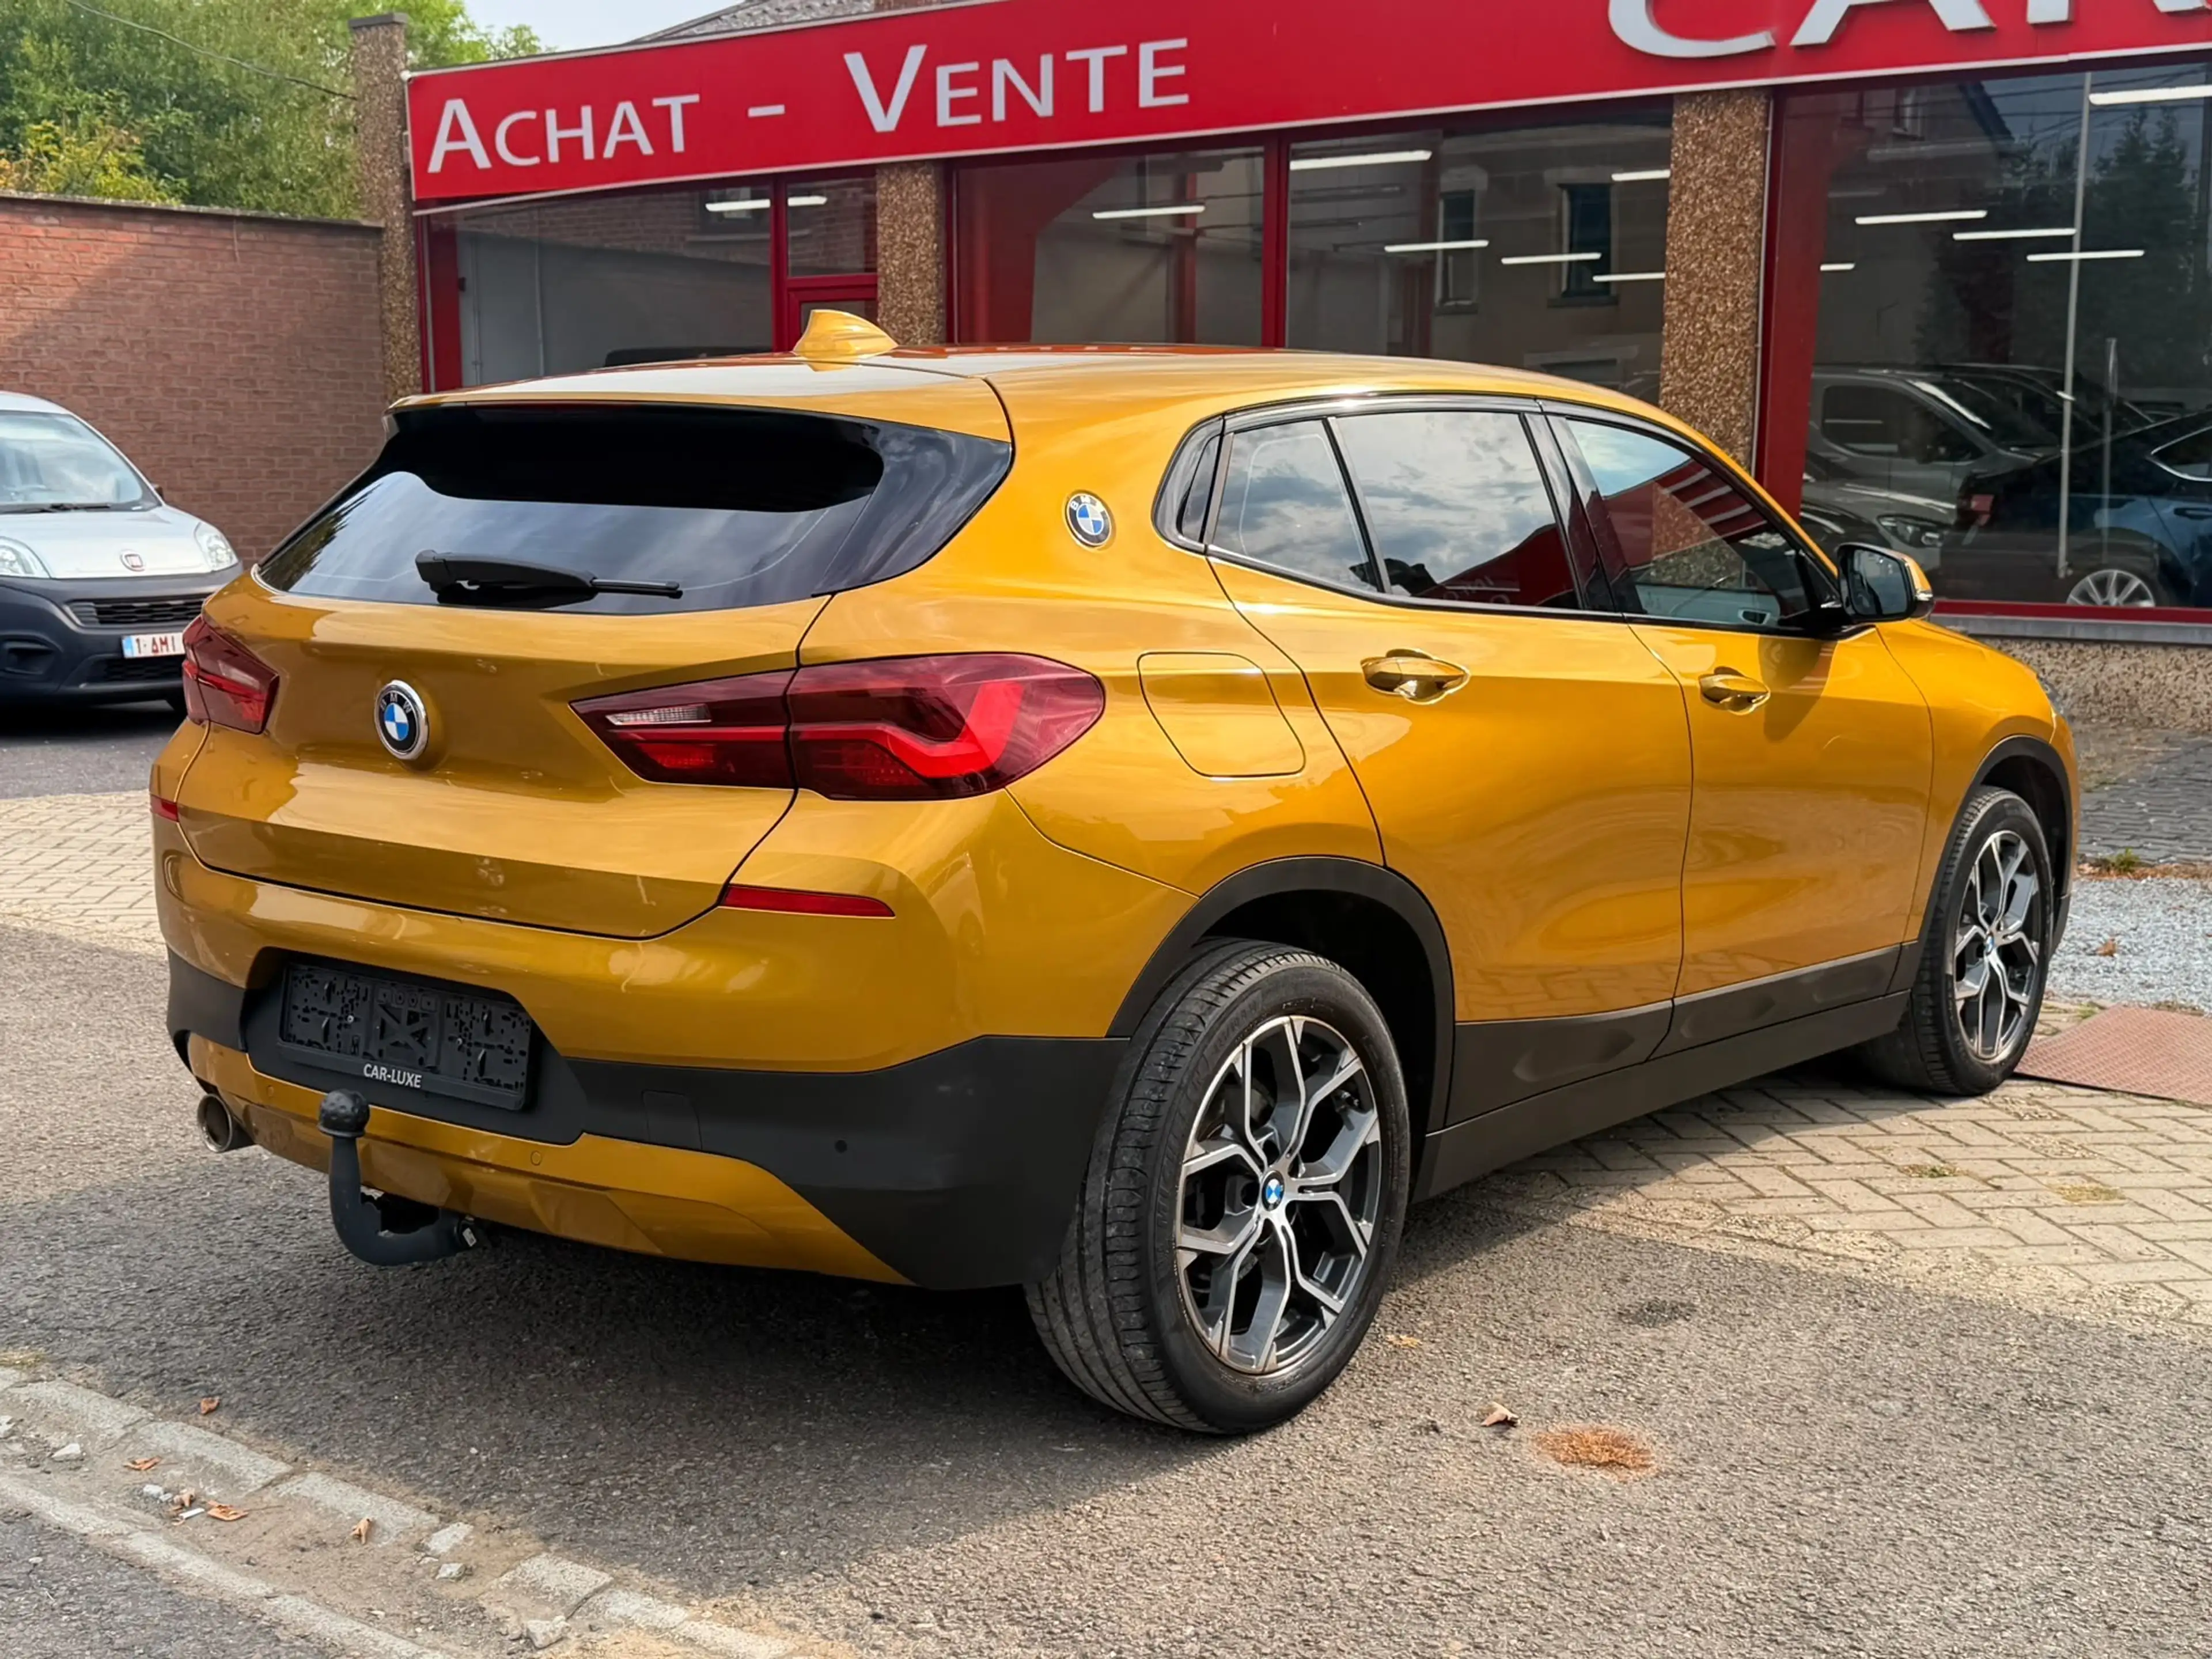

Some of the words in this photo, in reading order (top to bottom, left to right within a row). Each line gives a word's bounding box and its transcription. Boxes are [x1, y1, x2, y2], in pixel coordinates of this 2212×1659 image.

[427, 94, 700, 174] ACHAT
[843, 38, 1189, 132] VENTE
[380, 692, 412, 714] BMW
[363, 1063, 422, 1088] CAR-LUXE
